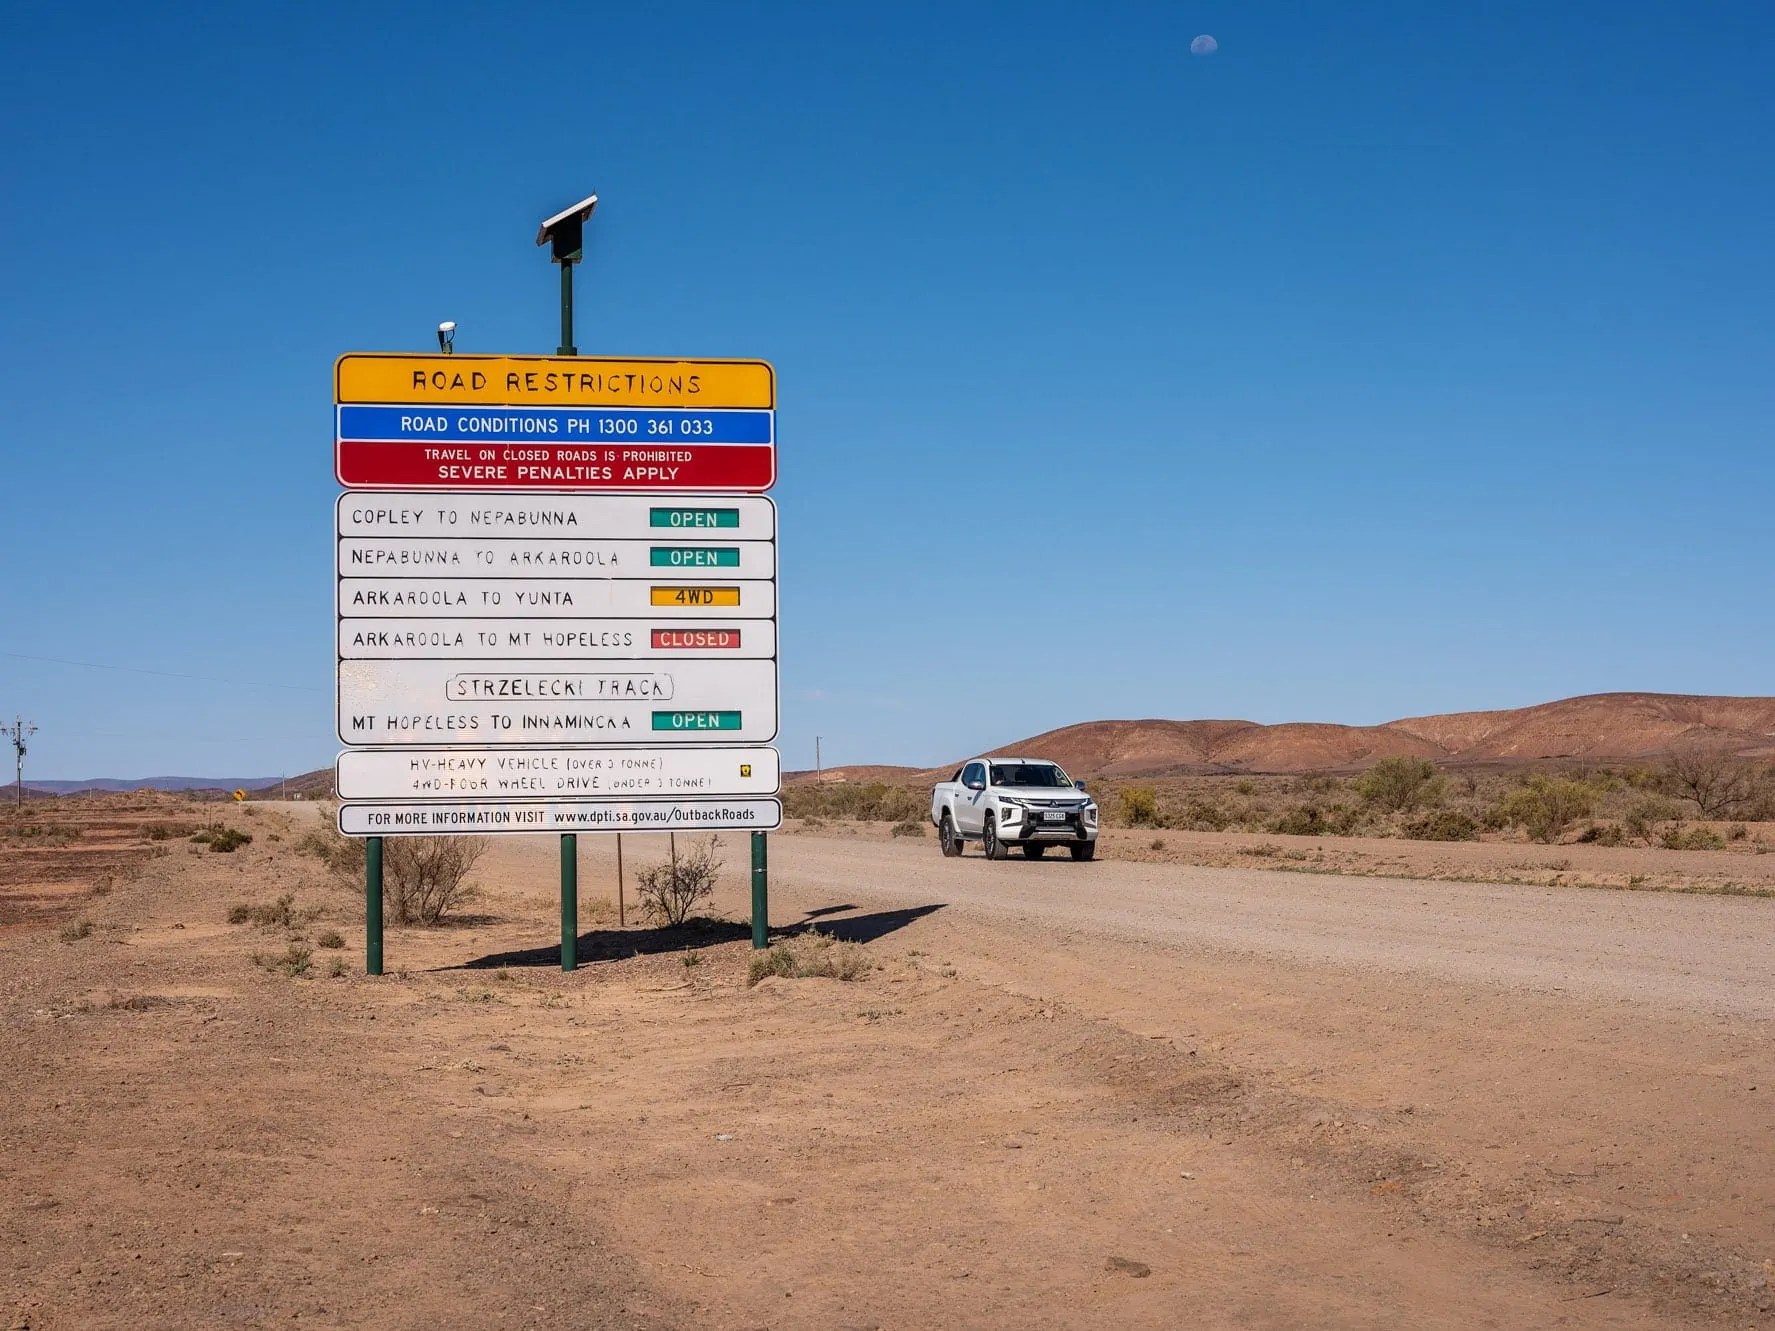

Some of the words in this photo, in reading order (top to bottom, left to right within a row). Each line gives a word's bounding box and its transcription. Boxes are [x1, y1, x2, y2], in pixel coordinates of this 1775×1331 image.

[413, 371, 487, 390] ROAD
[506, 372, 701, 394] RESTRICTIONS
[402, 417, 447, 431] ROAD
[458, 417, 558, 433] CONDITIONS
[568, 419, 589, 433] PH
[599, 419, 637, 433] 1300
[648, 420, 672, 434] 361
[681, 420, 712, 434] 033
[425, 449, 471, 460] TRAVEL
[479, 450, 495, 460] ON
[503, 450, 549, 460] CLOSED
[557, 451, 597, 461] ROADS
[605, 451, 615, 461] IS
[623, 451, 692, 461] PROHIBITED
[439, 466, 507, 479] SEVERE
[518, 466, 612, 479] PENALTIES
[623, 467, 679, 480] APPLY
[353, 510, 423, 524] COPLEY
[438, 511, 457, 524] TO
[471, 511, 577, 525] NEPABUNNA
[669, 512, 717, 528] OPEN
[352, 550, 460, 564] NEPABUNNA
[476, 551, 493, 564] TO
[511, 552, 617, 565] ARKAROOLA
[669, 551, 718, 566] OPEN
[353, 591, 466, 605] ARKAROOLA
[482, 592, 500, 605] TO
[515, 592, 573, 605] YUNTA
[674, 589, 714, 605] 4WD
[353, 632, 463, 646] ARKAROOLA
[478, 633, 496, 646] TO
[510, 632, 530, 646] MT
[544, 633, 632, 646] HOPELESS
[659, 632, 730, 647] CLOSED
[458, 679, 581, 696] STRZELECKI
[599, 680, 662, 695] TRACK
[353, 716, 375, 730] MT
[388, 715, 478, 729] HOPELESS
[491, 715, 511, 729] TO
[523, 715, 630, 728] INNAMINCKA
[672, 713, 720, 728] OPEN
[411, 758, 486, 770] HV-HEAVY
[497, 758, 558, 770] VEHICLE
[498, 777, 545, 790] WHEEL
[558, 776, 599, 788] DRIVE
[369, 814, 390, 824] FOR
[396, 813, 427, 824] MORE
[433, 812, 509, 824] INFORMATION
[515, 811, 544, 822] VISIT
[555, 807, 754, 824] www.dpti.sa.gov.au/OutbackRoads
